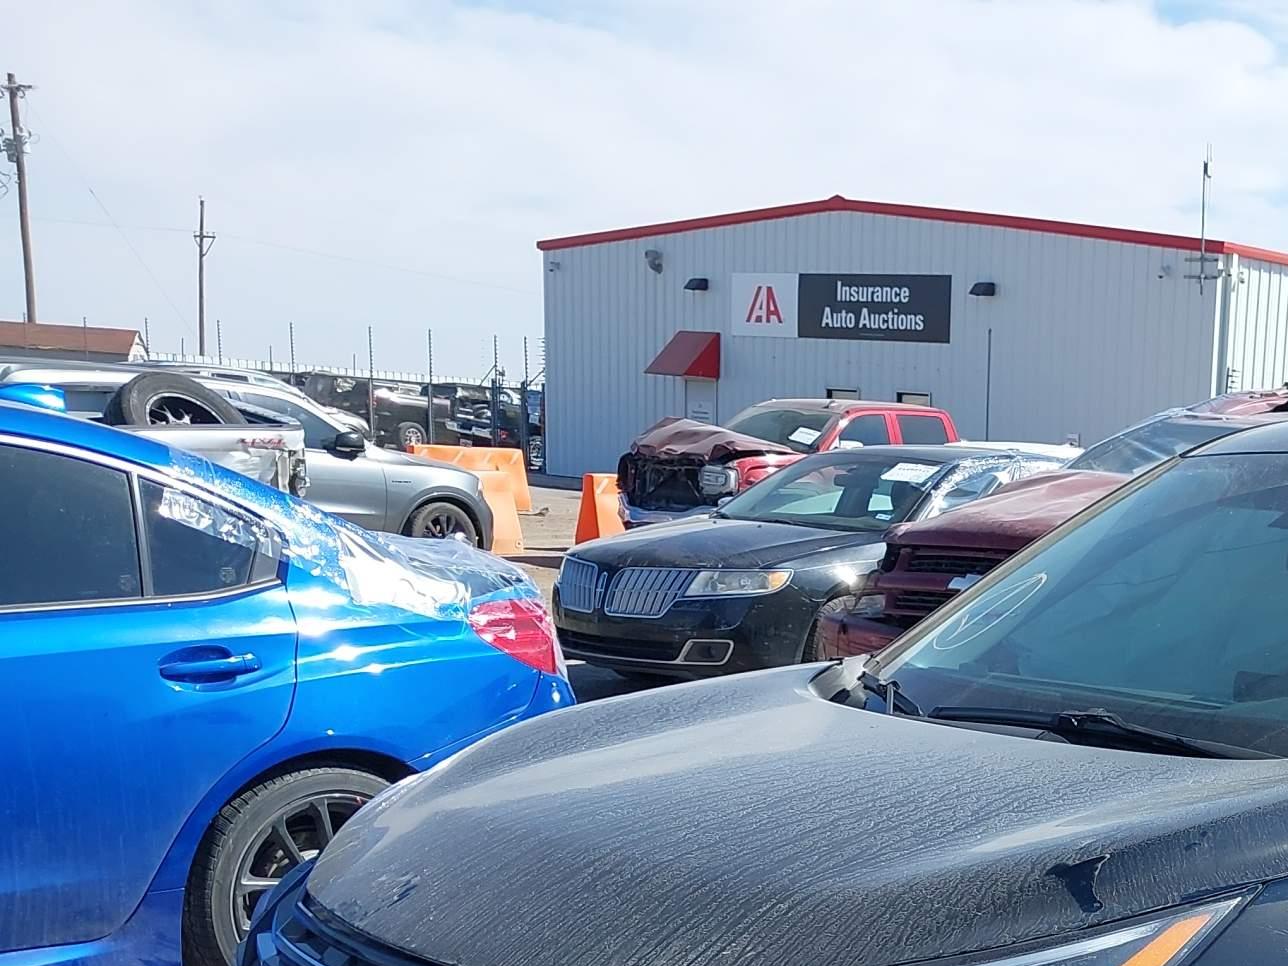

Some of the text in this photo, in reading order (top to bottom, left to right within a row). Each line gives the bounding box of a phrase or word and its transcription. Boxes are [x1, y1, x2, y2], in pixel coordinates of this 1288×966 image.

[836, 280, 910, 303] Insurance
[821, 307, 924, 331] Auto Auctions
